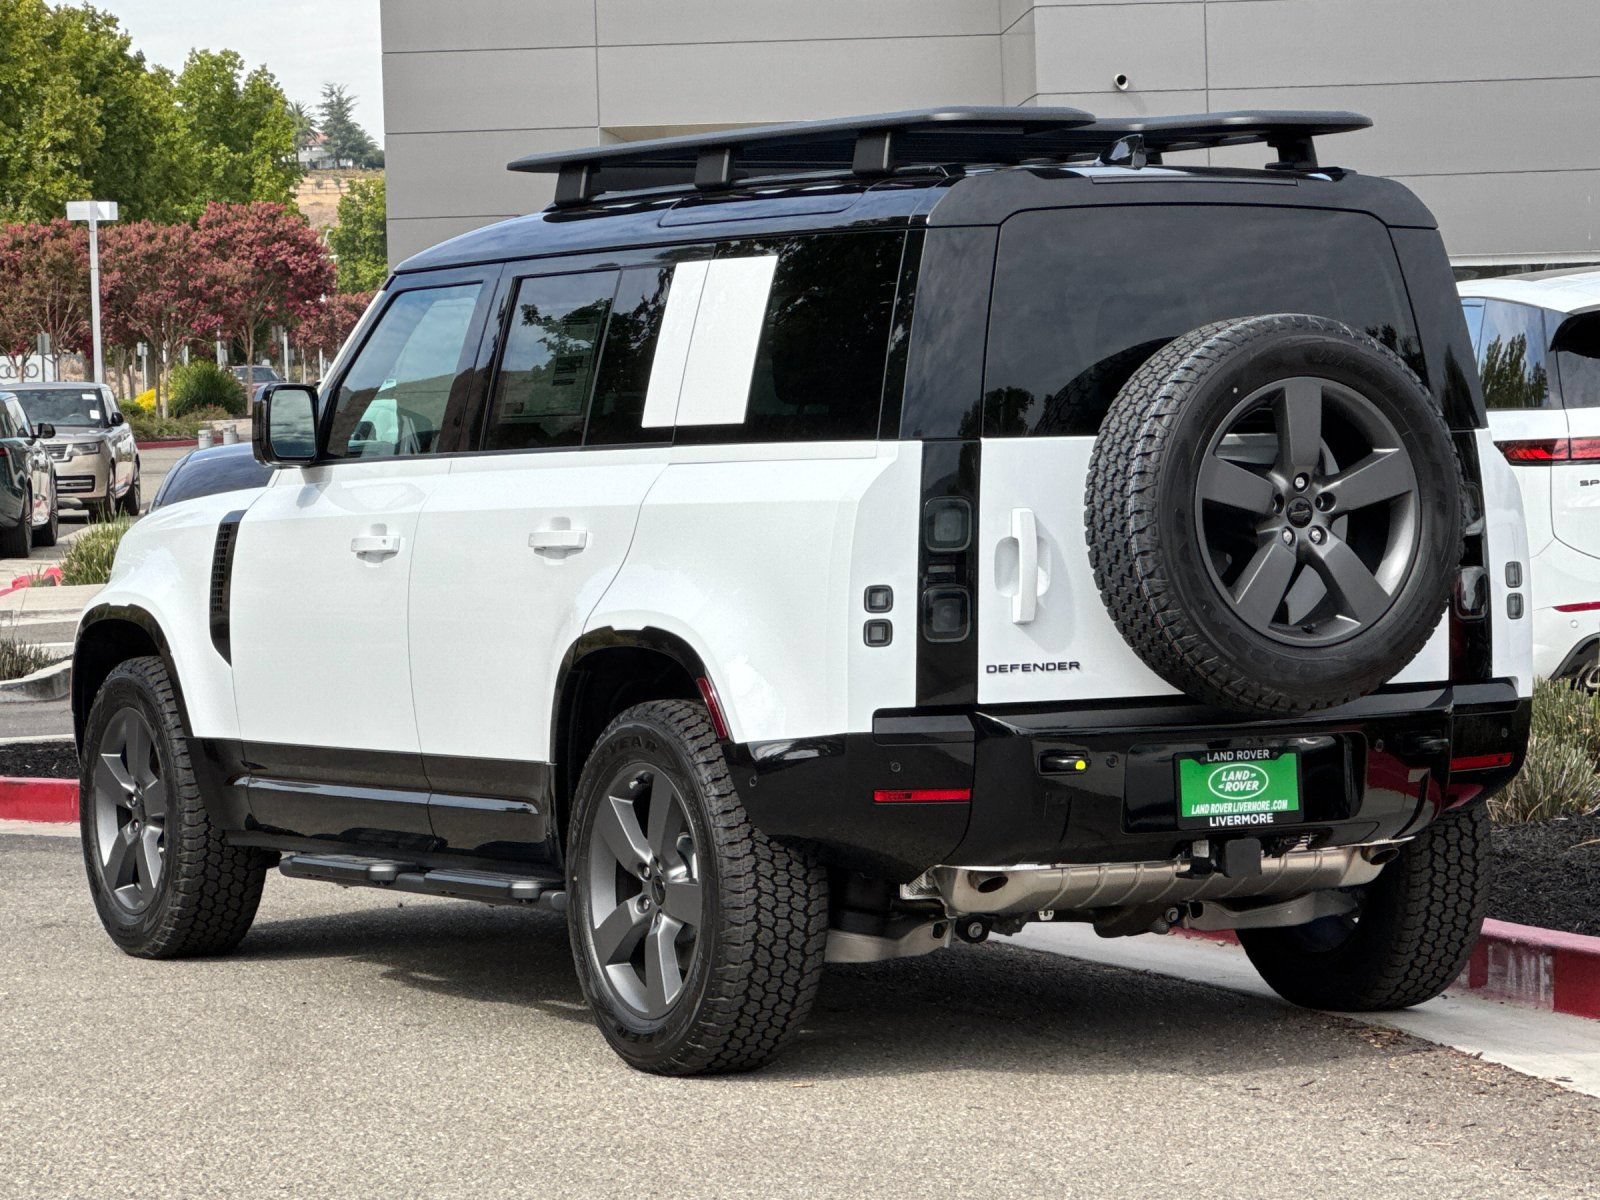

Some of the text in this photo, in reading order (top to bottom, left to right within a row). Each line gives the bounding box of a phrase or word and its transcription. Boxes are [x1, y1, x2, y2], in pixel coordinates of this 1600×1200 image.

[986, 661, 1081, 674] DEFENDER
[1206, 749, 1270, 762] LAND ROVER
[1221, 770, 1250, 781] LAND
[1224, 780, 1259, 792] ROVER
[1191, 804, 1209, 815] LAND
[1210, 802, 1233, 814] ROVER
[1209, 813, 1274, 827] LIVERMORE
